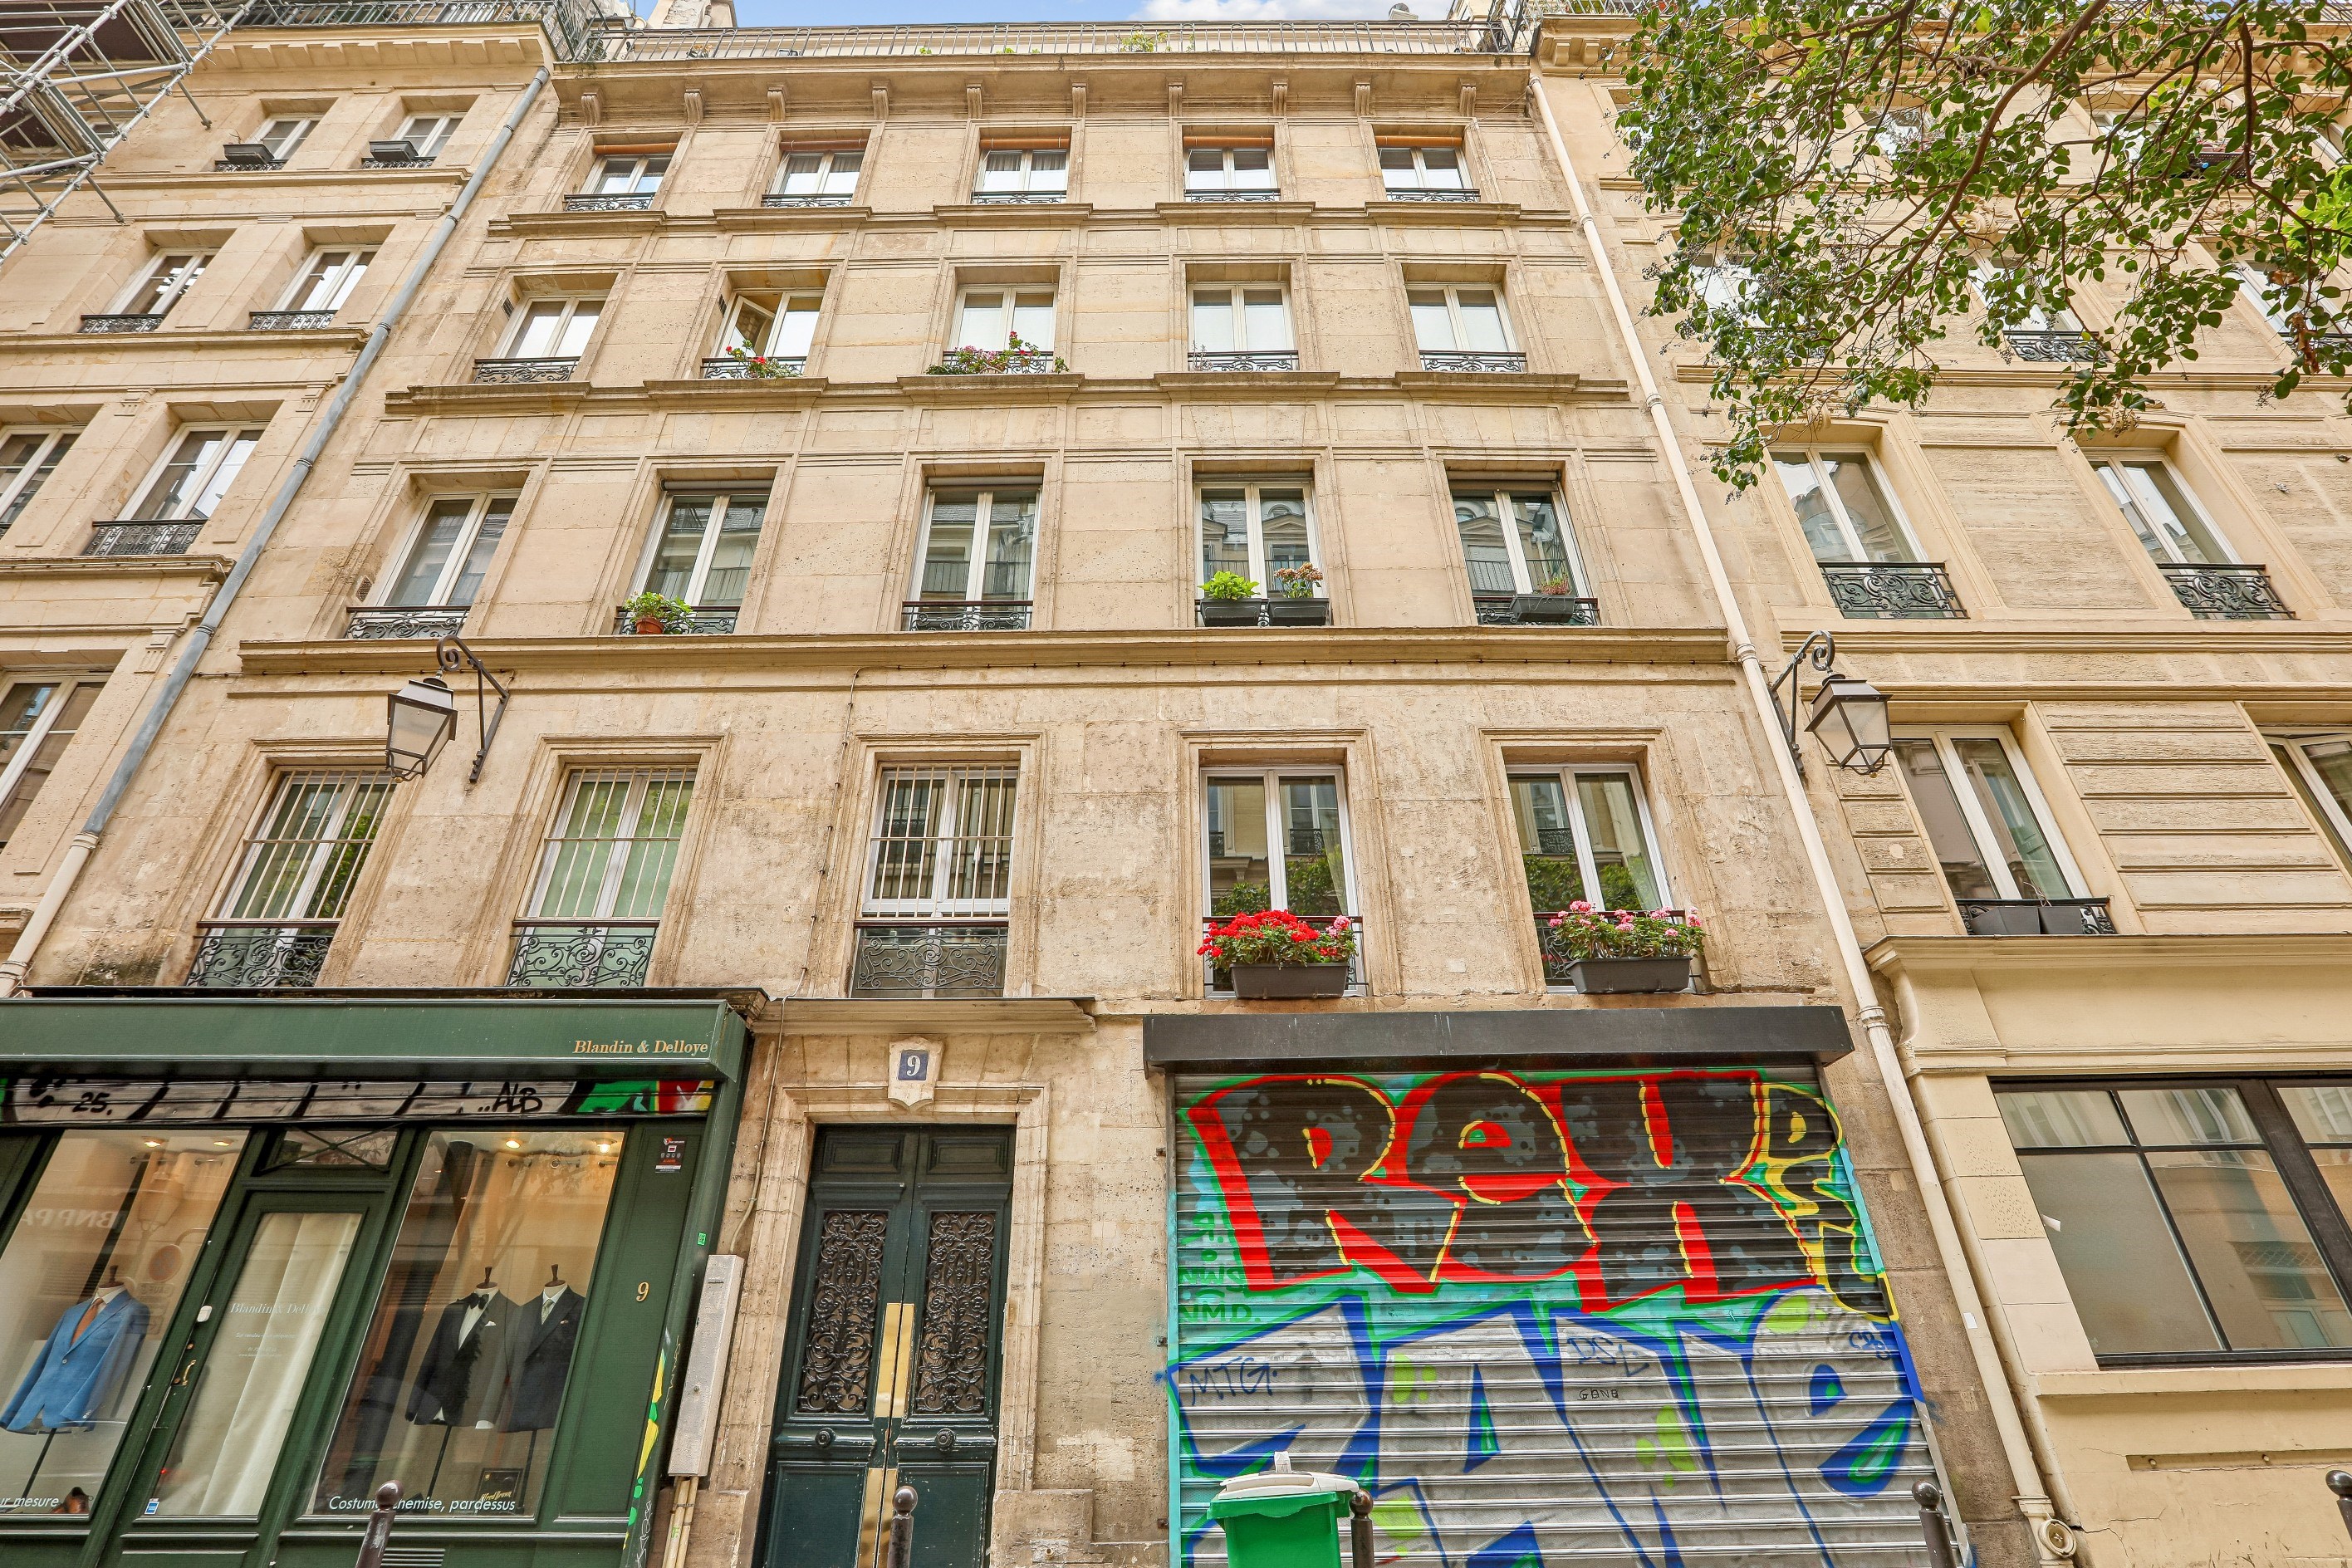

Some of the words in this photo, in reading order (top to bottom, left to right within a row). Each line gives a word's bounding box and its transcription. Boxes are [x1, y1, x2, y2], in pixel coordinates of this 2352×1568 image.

[572, 1040, 634, 1054] Blandin
[637, 1040, 649, 1053] &
[652, 1040, 708, 1056] Delloye
[906, 1055, 921, 1076] 9
[635, 1281, 649, 1302] 9
[230, 1303, 273, 1314] Blandin
[13, 1497, 59, 1507] mesure
[329, 1496, 379, 1510] Costum
[449, 1497, 515, 1513] pardessus
